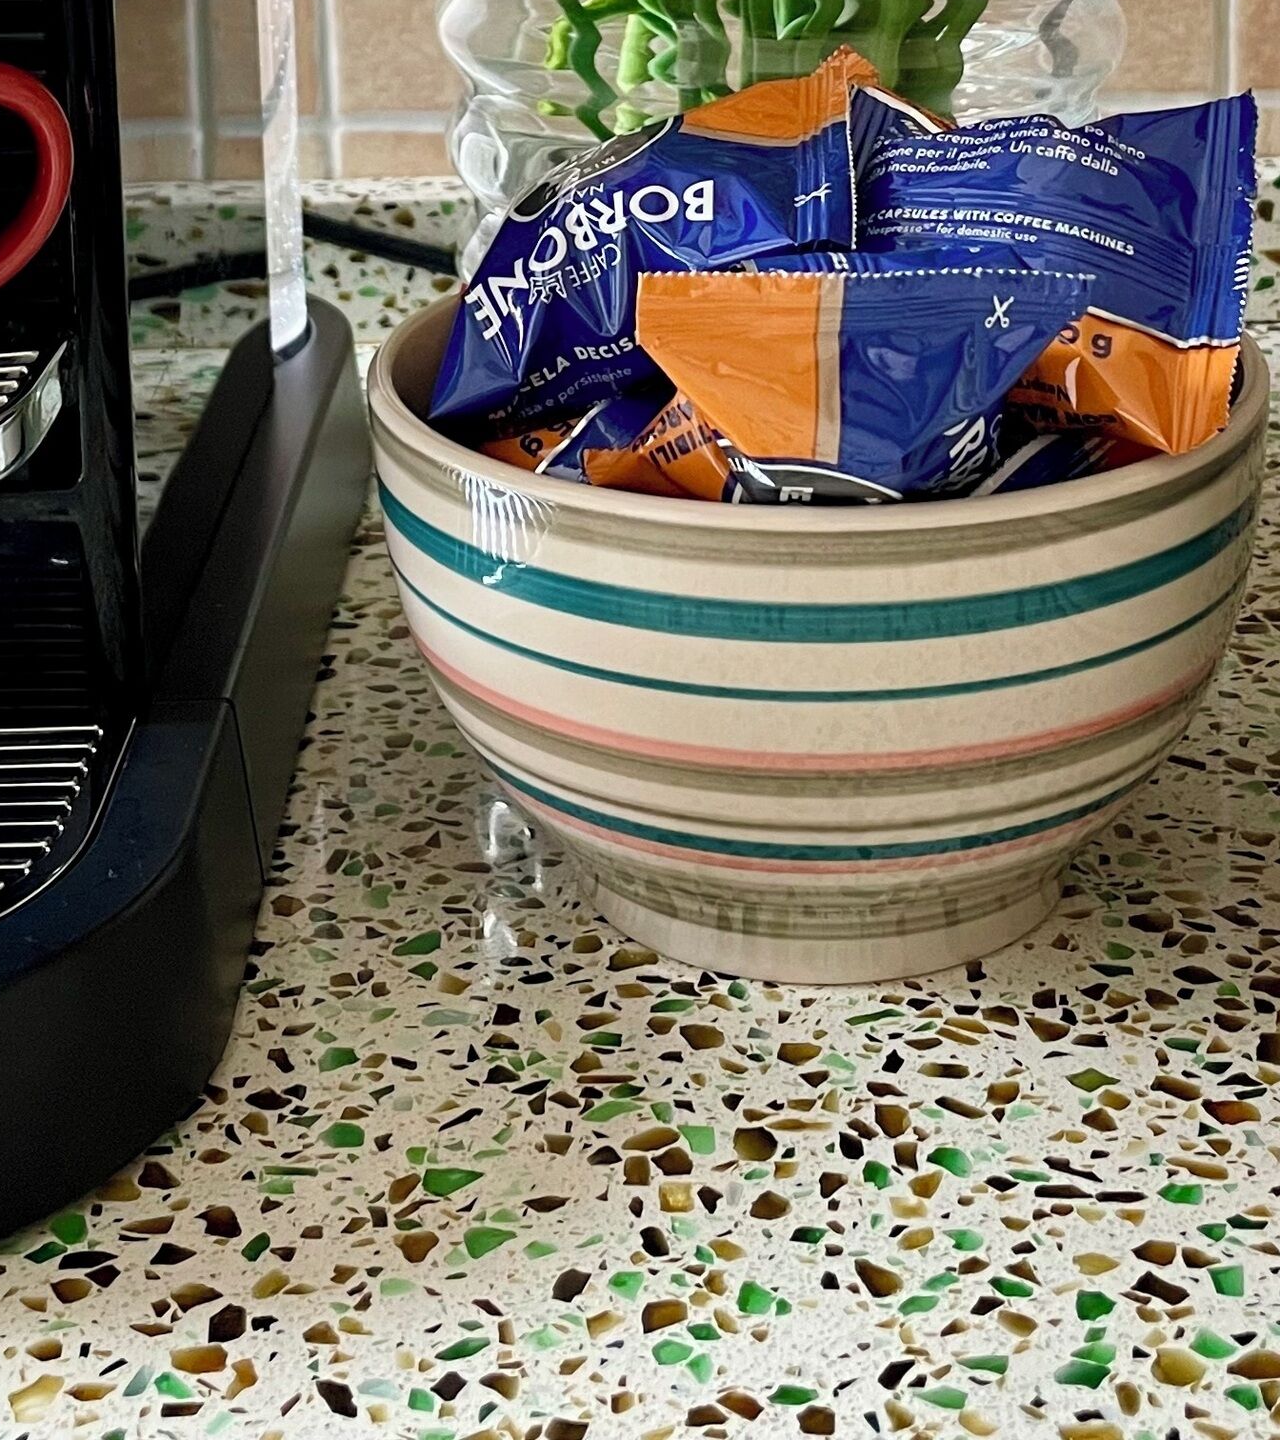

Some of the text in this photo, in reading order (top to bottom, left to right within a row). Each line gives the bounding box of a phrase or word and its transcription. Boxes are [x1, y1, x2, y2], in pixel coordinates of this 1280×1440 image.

[915, 147, 944, 159] per
[946, 147, 957, 158] il
[1009, 141, 1031, 153] Un
[1036, 144, 1077, 161] caffè
[1081, 153, 1118, 176] dalla
[1010, 126, 1048, 138] unica
[1052, 129, 1090, 147] sono
[1095, 142, 1122, 160] una
[1107, 134, 1145, 160] pieno
[887, 159, 991, 173] inconfondibile.
[878, 208, 1134, 255] CAPSULES WITH COFFEE MACHINES
[936, 223, 955, 234] for
[957, 224, 1012, 239] domestic
[1015, 232, 1037, 243] use
[465, 179, 714, 341] BORBONE
[569, 242, 621, 292] CAFFÈ
[574, 337, 635, 362] DECIS
[1091, 333, 1113, 358] g
[557, 366, 632, 404] persistente
